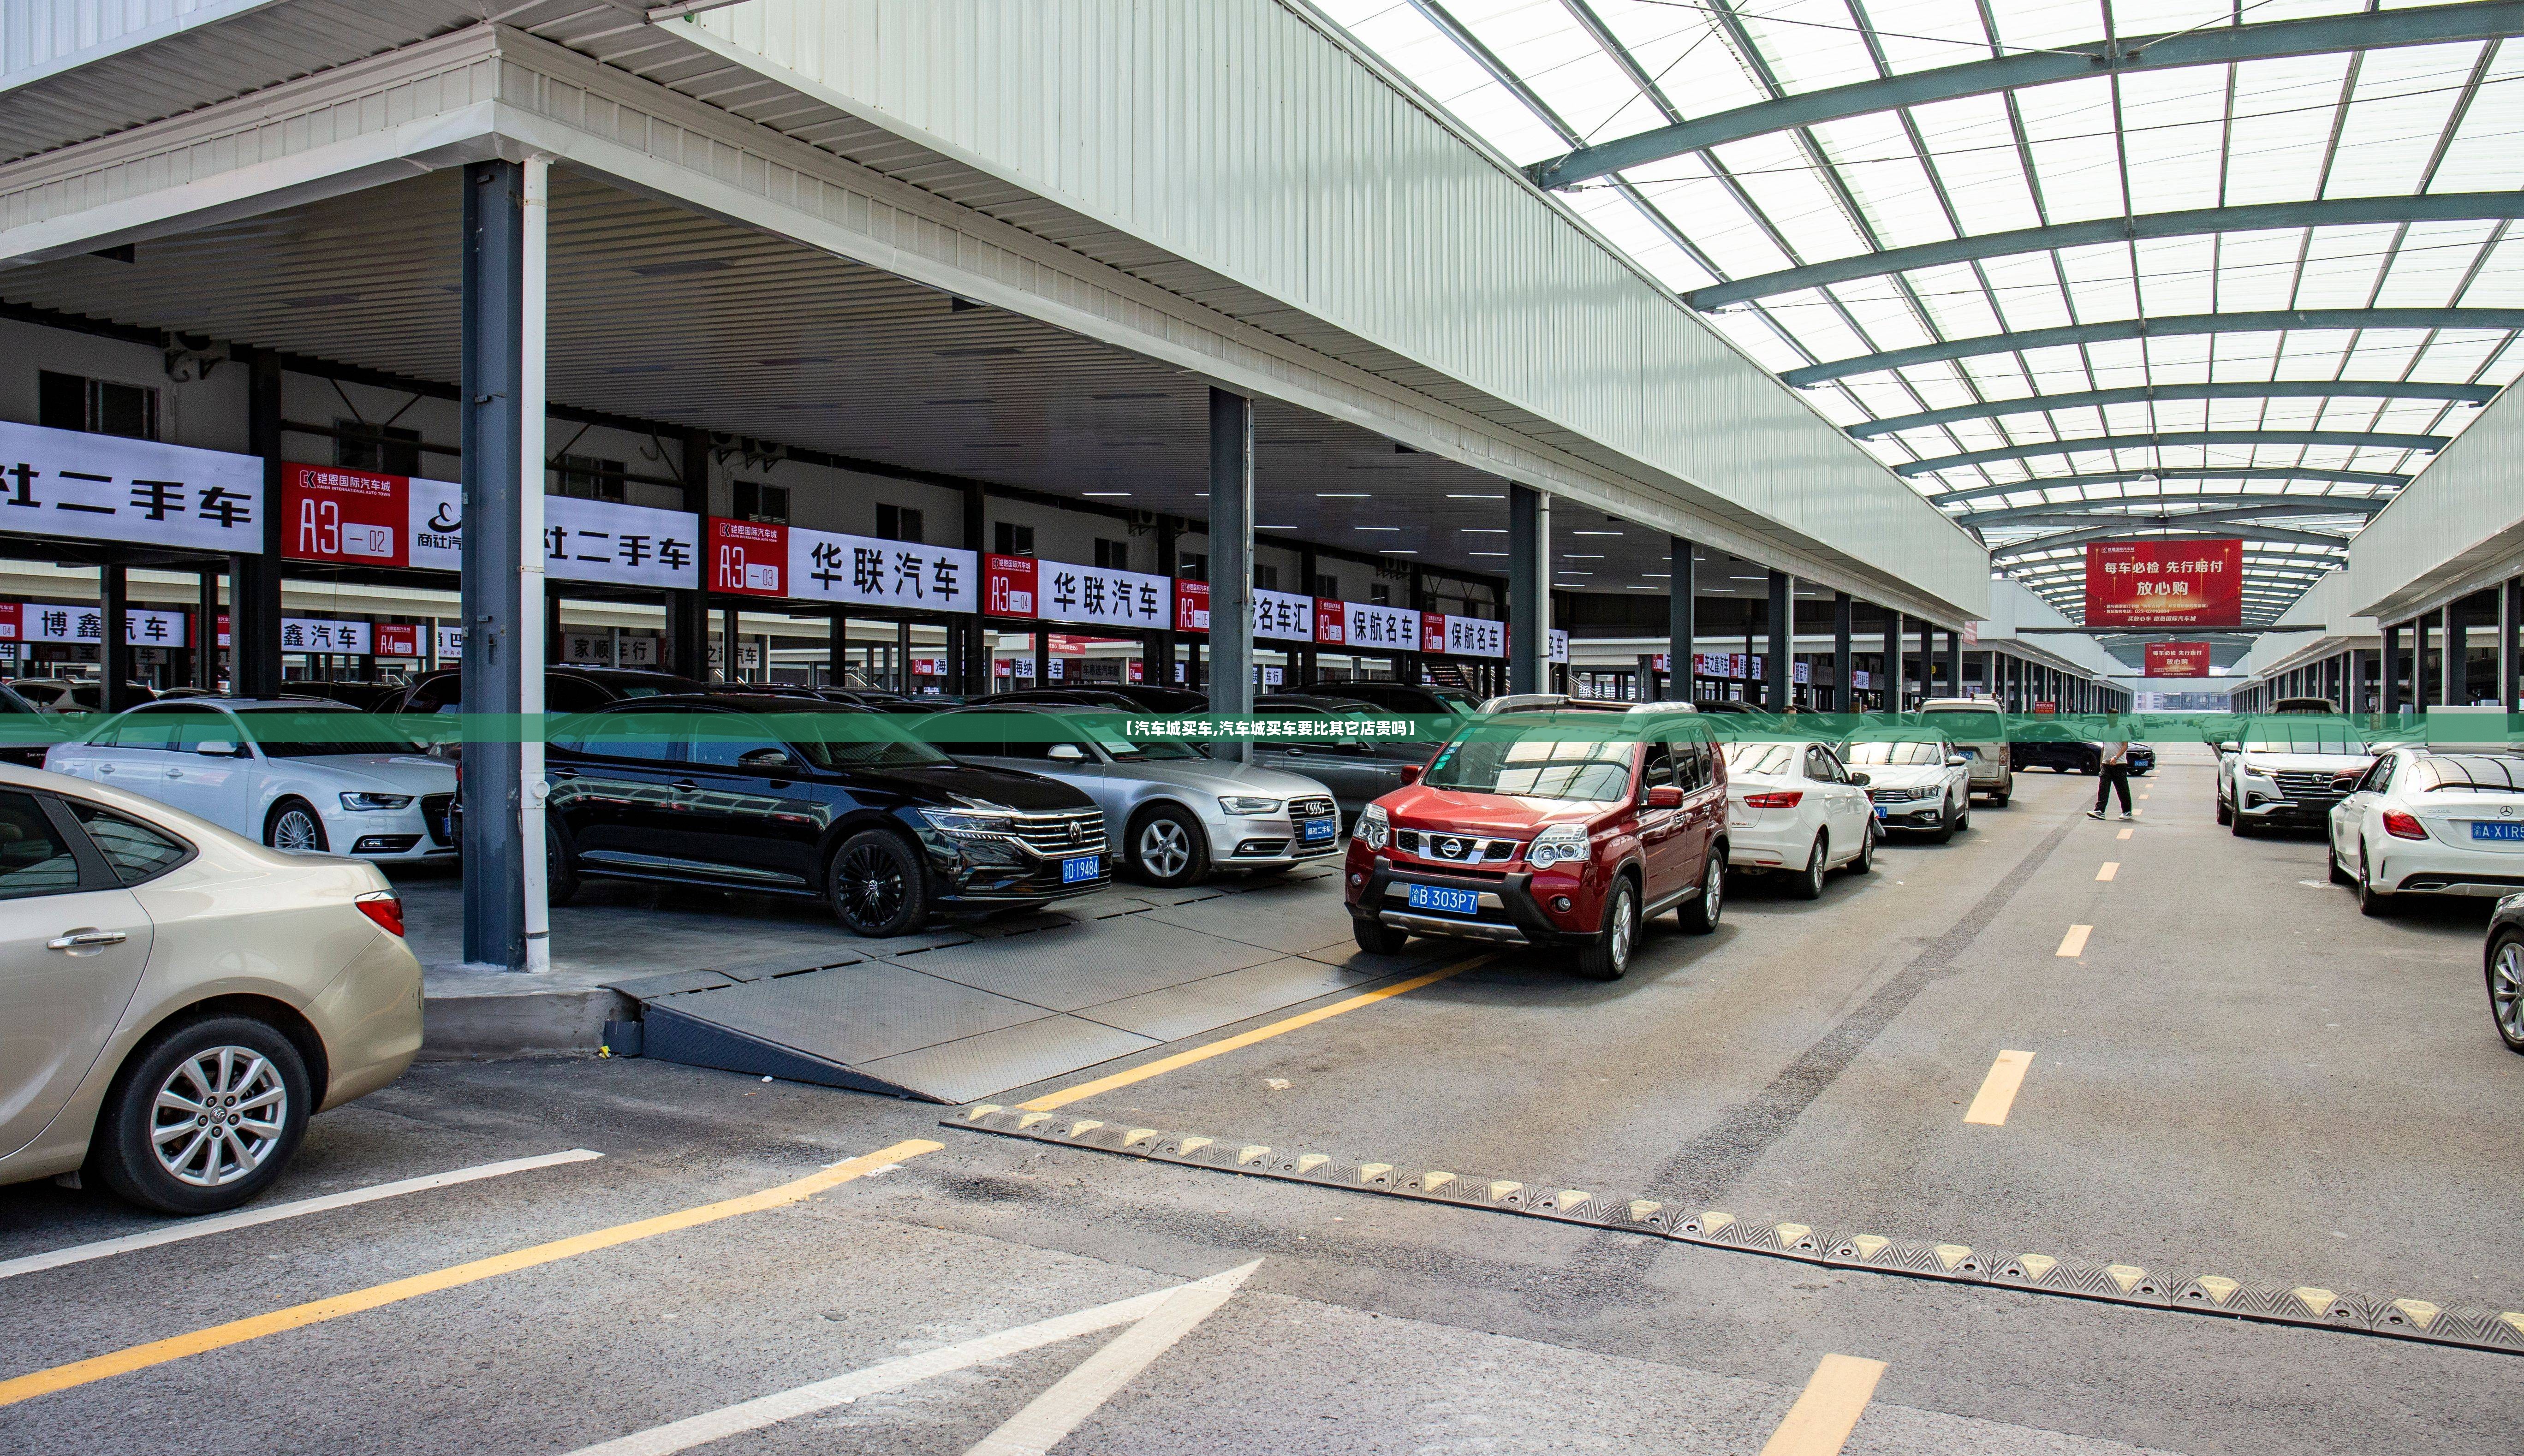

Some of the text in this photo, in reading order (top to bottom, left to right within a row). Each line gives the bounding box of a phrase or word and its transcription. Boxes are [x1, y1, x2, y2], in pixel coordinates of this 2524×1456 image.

[317, 473, 391, 492] 铠恩国际汽车城
[299, 499, 338, 554] A3
[731, 525, 777, 538] 铠恩国际汽车城
[719, 545, 744, 588] A3
[810, 541, 959, 602] 华联汽车
[2104, 560, 2223, 574] 每车必检 先行赔付
[992, 576, 1008, 611] A3
[1054, 571, 1158, 620] 华联汽车
[2137, 581, 2189, 596] 放心购
[1181, 598, 1193, 628] A3
[284, 624, 357, 648] 鑫汽车
[1320, 614, 1329, 640] A3
[1353, 610, 1412, 644] 保航名车
[1425, 626, 1433, 649] A3
[1452, 622, 1498, 652] 保航名车
[381, 635, 393, 653] A4
[915, 660, 922, 673] B4
[995, 663, 1002, 676] B4
[1705, 654, 1728, 674] 车之鑫汽车
[1308, 826, 1331, 835] 商社二手车
